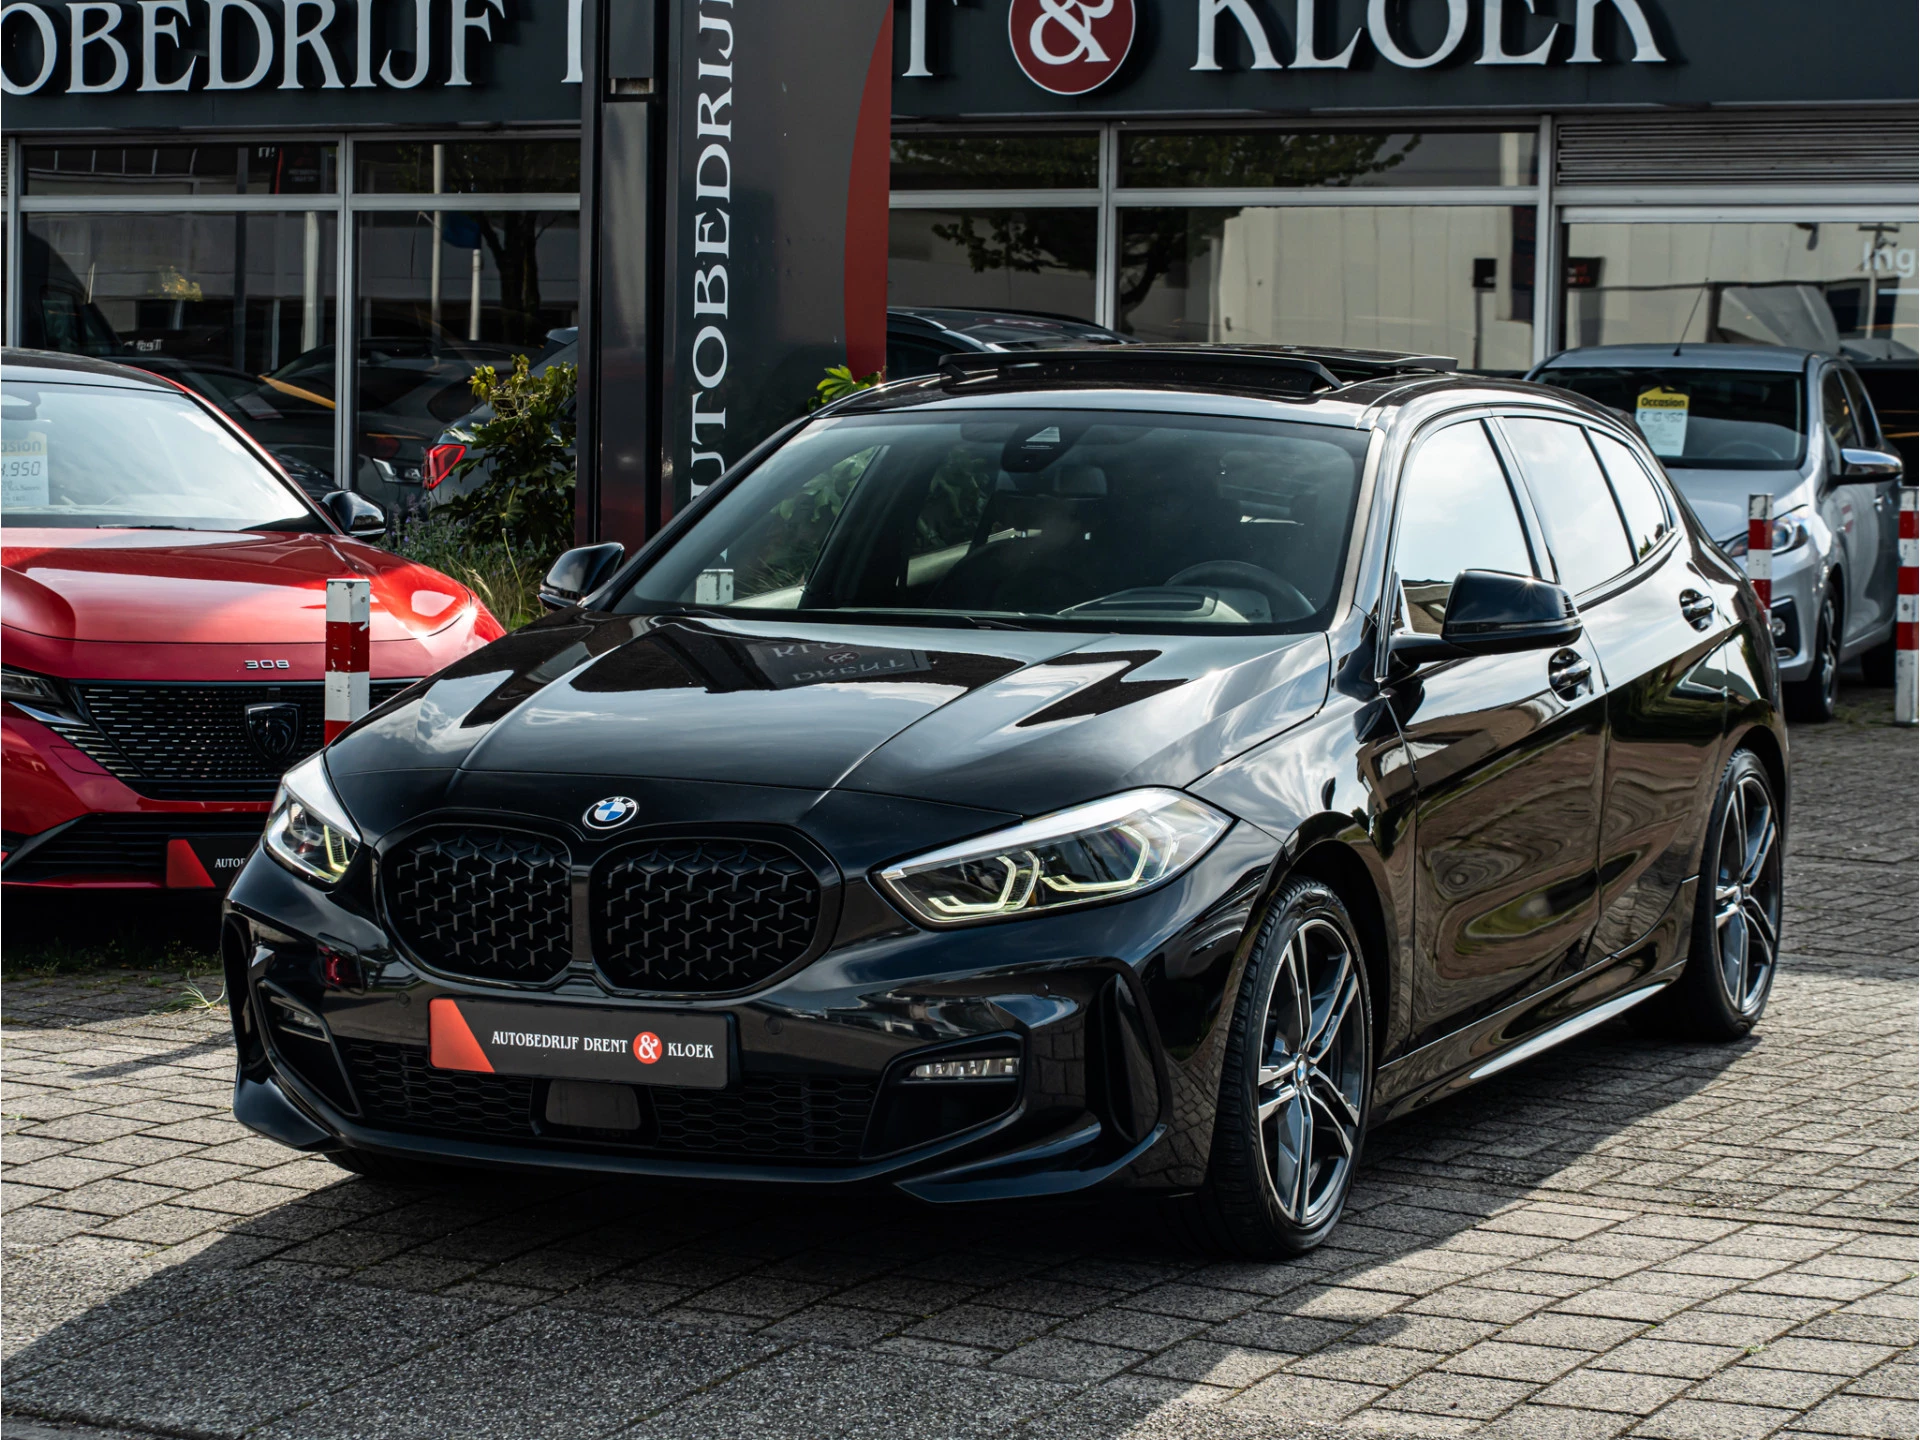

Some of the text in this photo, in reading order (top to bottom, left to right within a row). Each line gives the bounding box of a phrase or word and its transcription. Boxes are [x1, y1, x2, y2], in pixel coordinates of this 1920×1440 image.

[690, 0, 733, 501] UTOBEDRIJ
[1641, 397, 1686, 408] Occasion
[244, 659, 290, 669] 308
[491, 1030, 714, 1060] AUTOBEDRIJF DRENT & KLOEK
